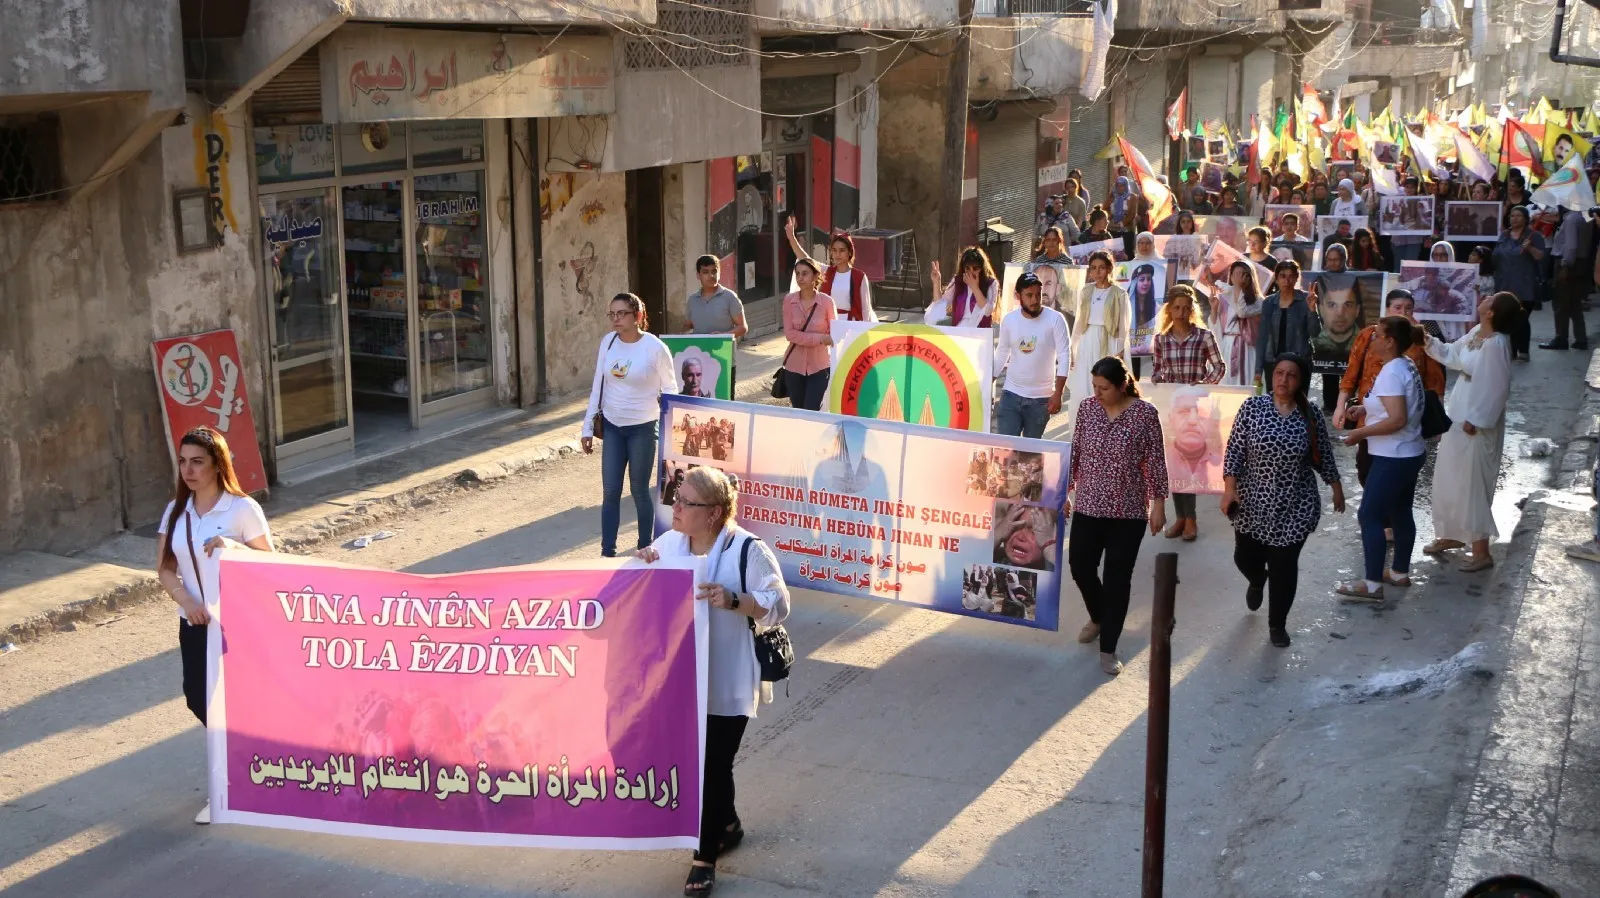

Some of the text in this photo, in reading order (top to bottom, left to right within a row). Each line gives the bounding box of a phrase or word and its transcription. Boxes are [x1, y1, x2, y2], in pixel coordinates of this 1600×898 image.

[299, 125, 333, 142] LOVE
[312, 152, 335, 168] style
[265, 215, 323, 251] صيدلية
[738, 480, 992, 531] ARASTINA RÛMETA JINÊN ŞENGALÊ
[743, 506, 960, 552] PARASTINA HEBÛNA JINAN NE
[774, 536, 926, 574] صون كرامة المرأة الشنكالية
[799, 560, 903, 593] صون كرامة المرأة
[275, 585, 605, 630] VÎNA JİNÊN AZAD
[301, 634, 579, 677] TOLA ÊZDİYAN
[250, 752, 679, 811] إرادة المرأة الحرة هو انتقام للإيزيديين
